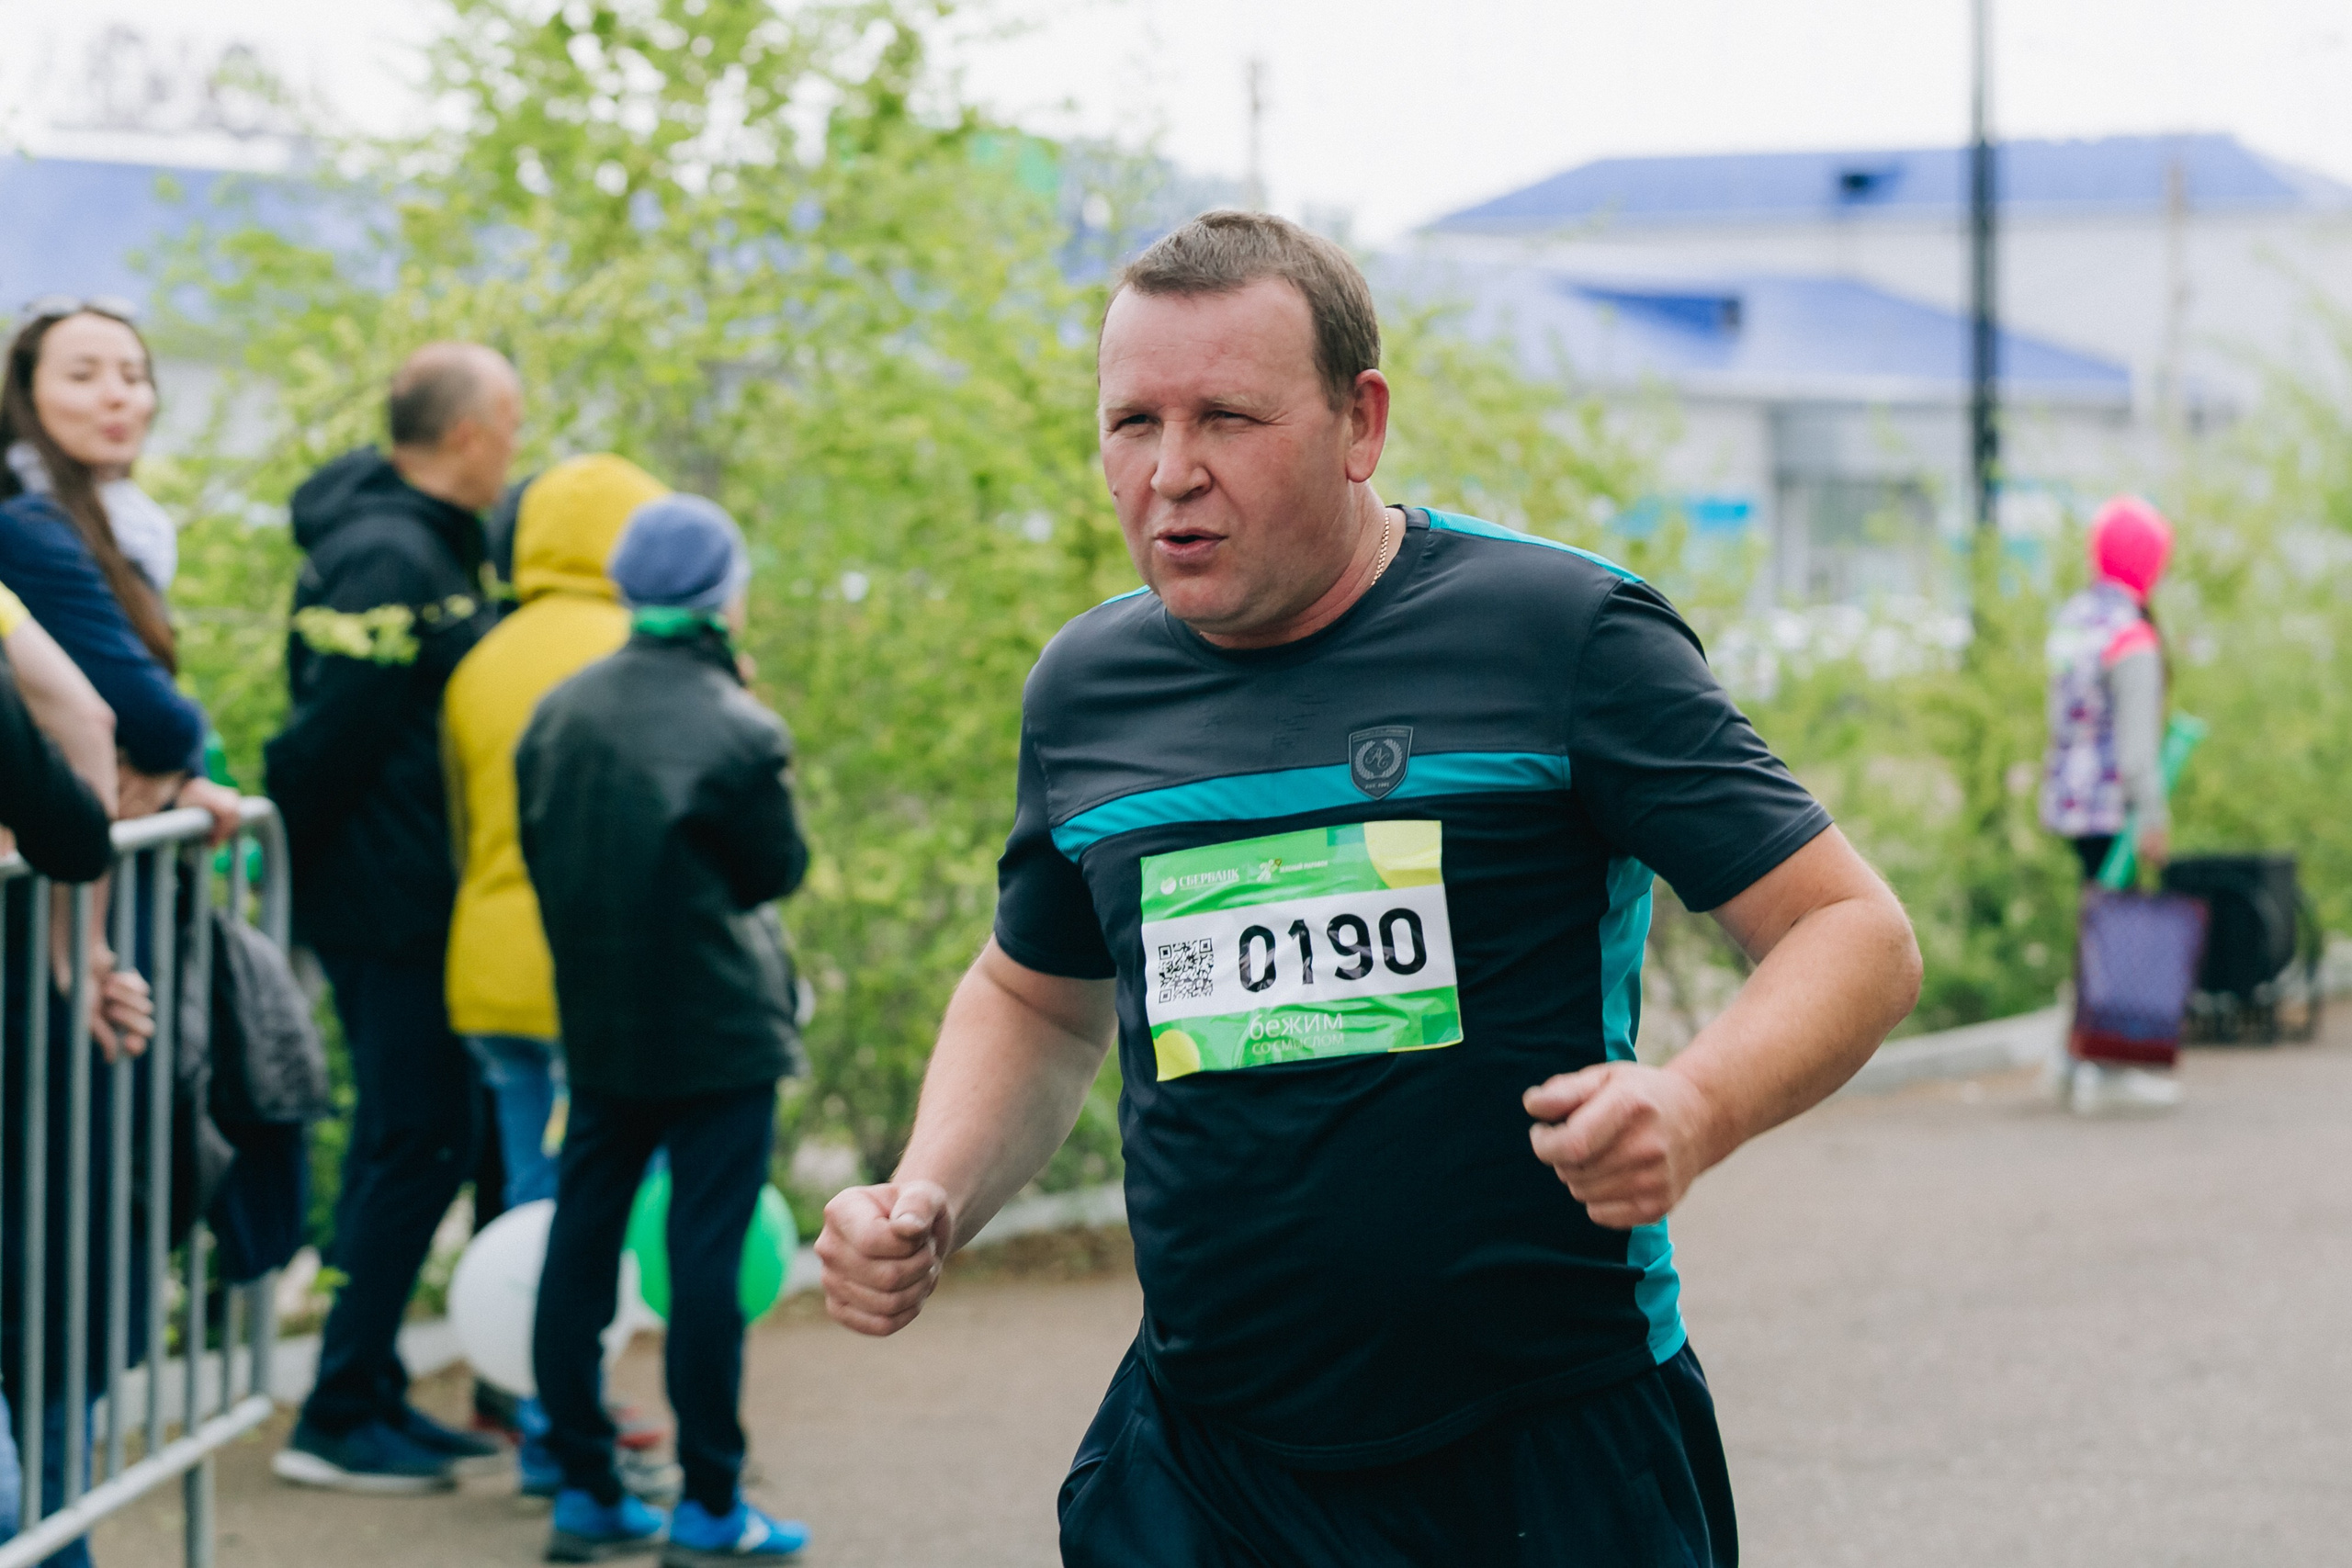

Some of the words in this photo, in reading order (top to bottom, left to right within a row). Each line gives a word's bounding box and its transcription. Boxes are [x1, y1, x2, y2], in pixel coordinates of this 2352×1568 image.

[1179, 868, 1239, 888] СБЕРБАНК
[1238, 907, 1428, 993] 0190
[1250, 1012, 1343, 1041] бежим
